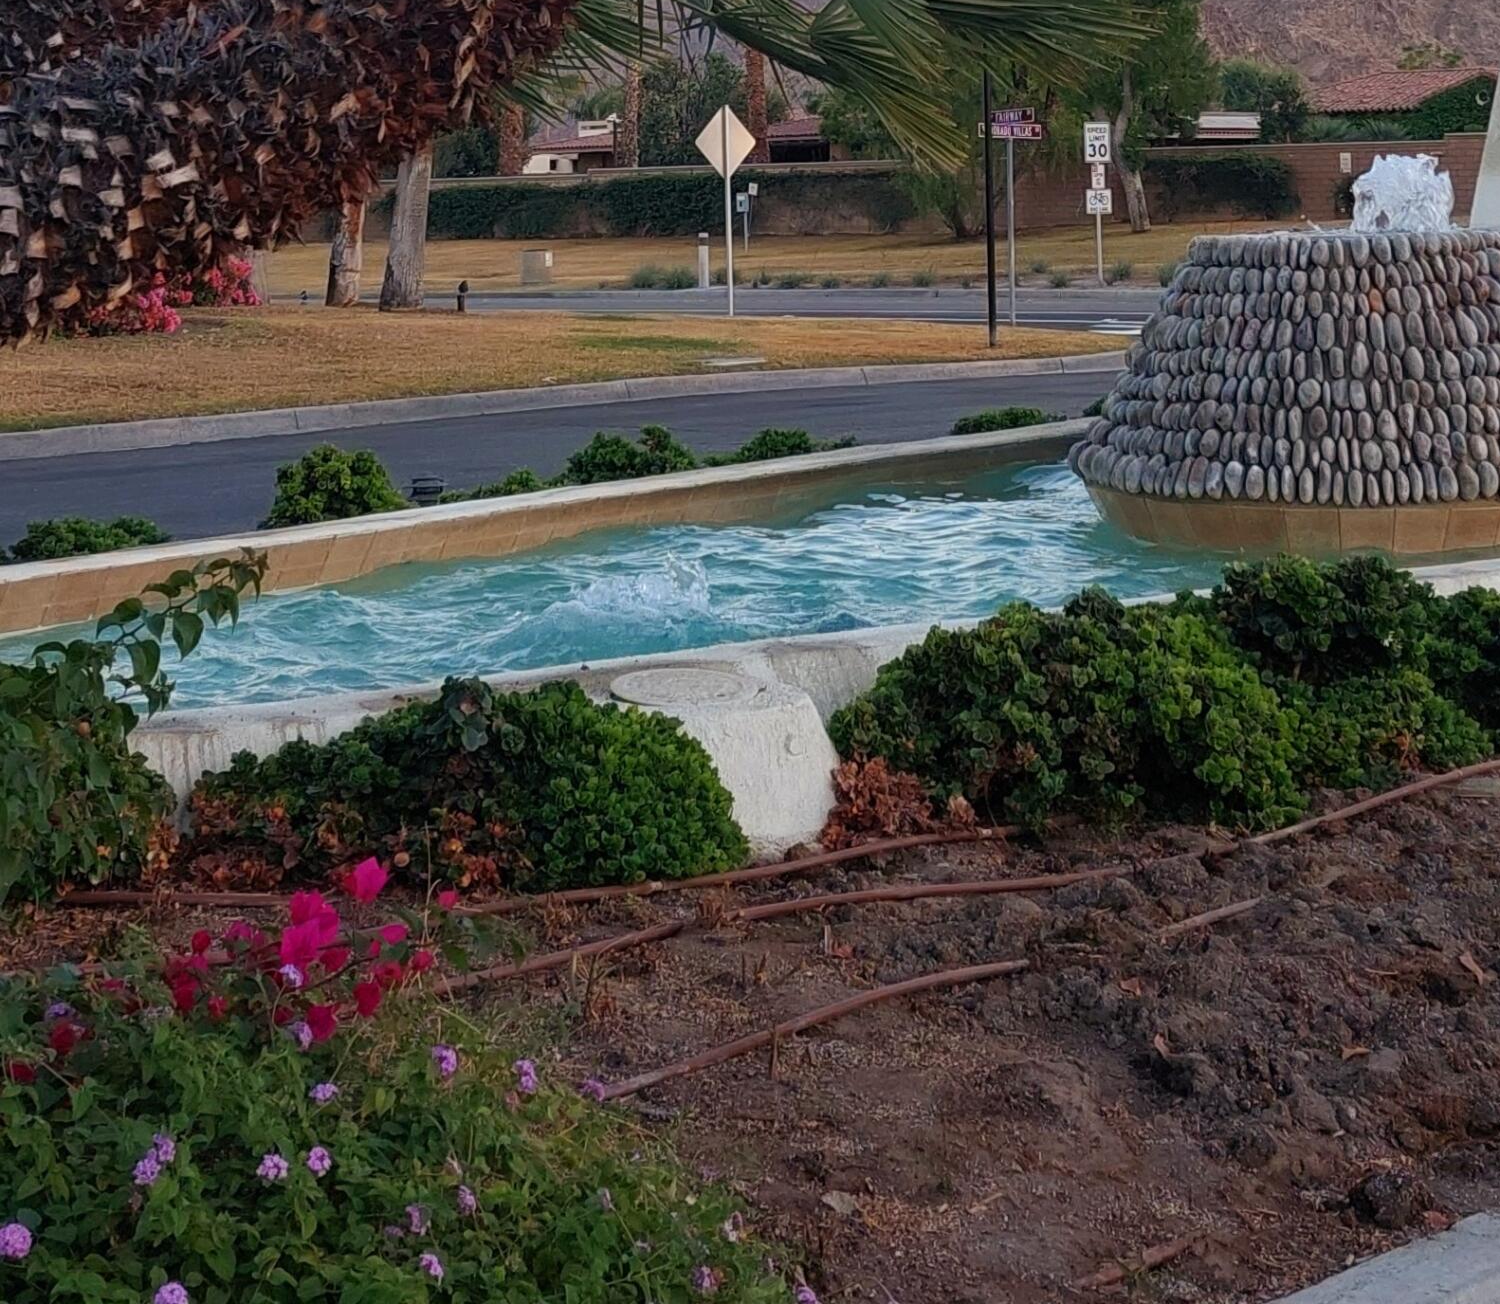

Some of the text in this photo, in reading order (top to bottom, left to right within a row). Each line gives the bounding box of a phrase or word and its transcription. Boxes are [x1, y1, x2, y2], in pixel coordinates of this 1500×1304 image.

[995, 110, 1022, 123] FAIRWAY
[991, 125, 1012, 136] ORADO
[1013, 126, 1032, 137] VILLAS
[1088, 143, 1108, 157] 30
